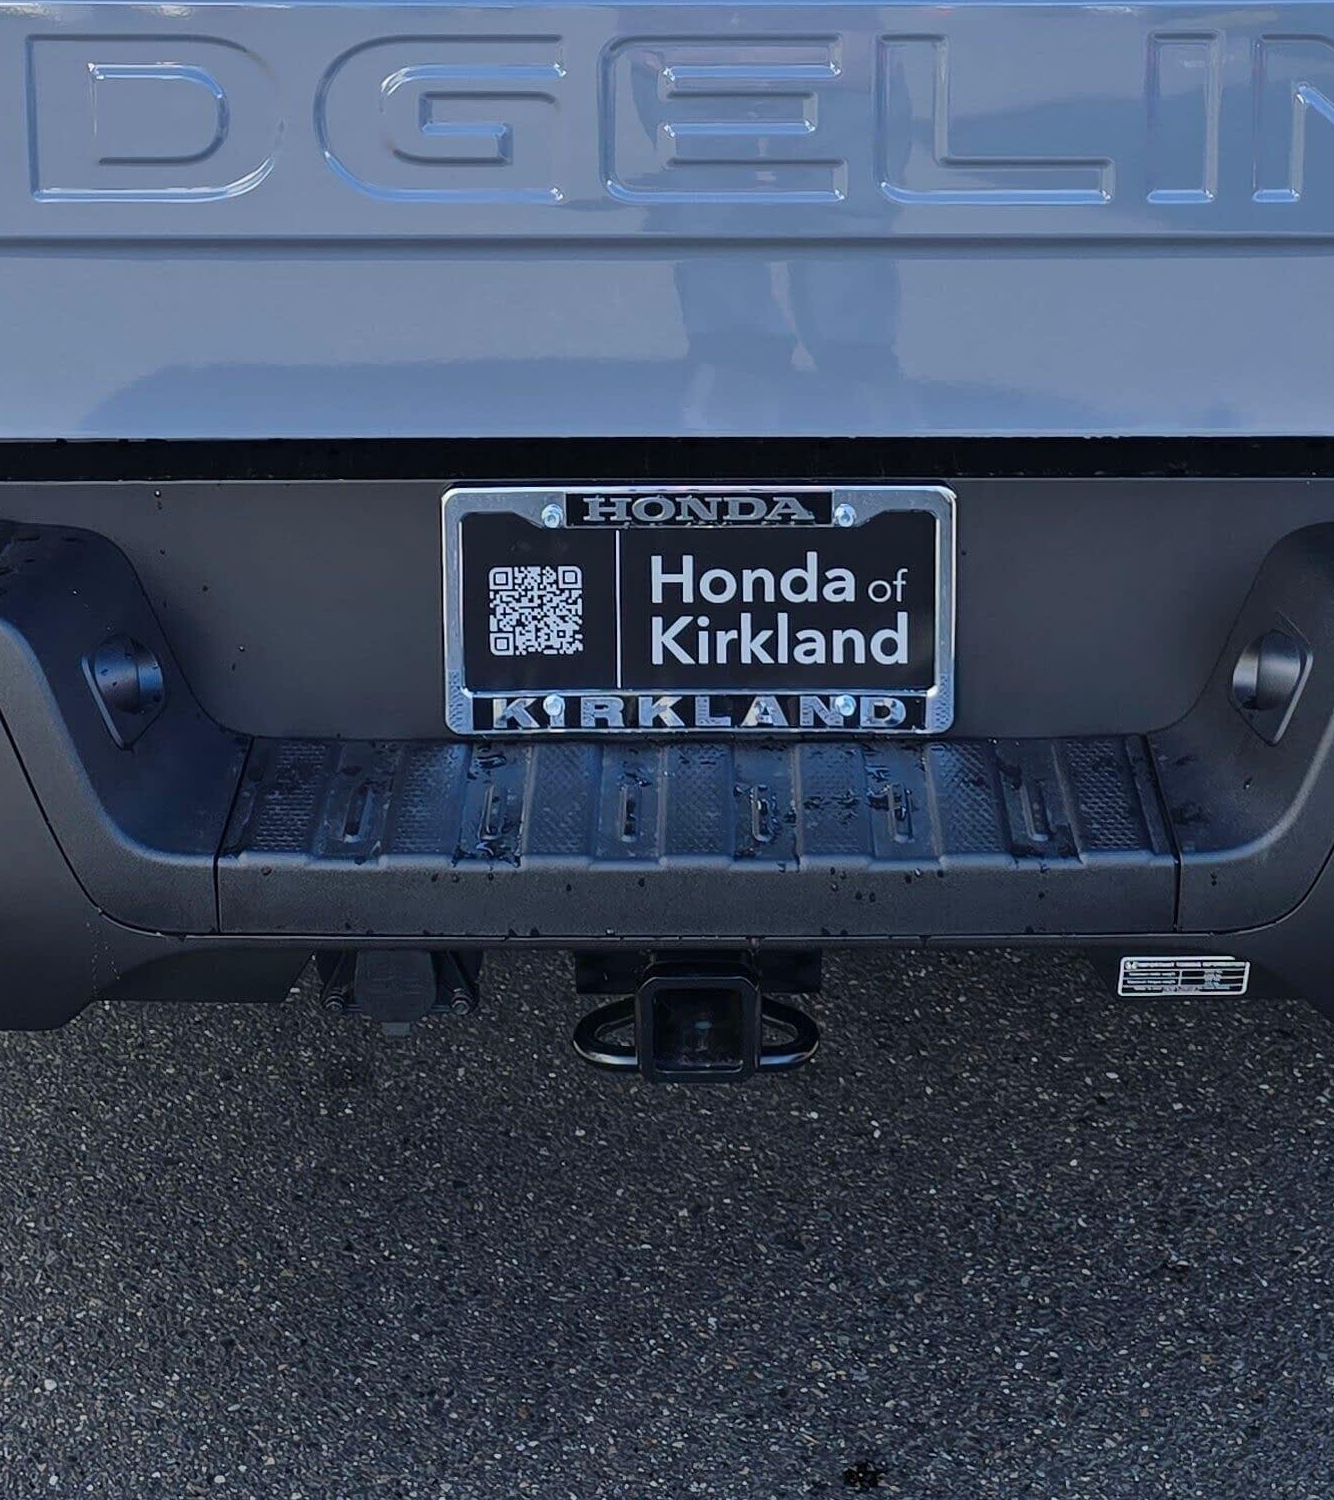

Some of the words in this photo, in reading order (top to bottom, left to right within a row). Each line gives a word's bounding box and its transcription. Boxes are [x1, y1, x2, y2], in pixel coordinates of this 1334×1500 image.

[581, 496, 816, 523] HONDA
[650, 550, 856, 604] Honda
[866, 567, 909, 603] of
[650, 611, 909, 665] Kirkland
